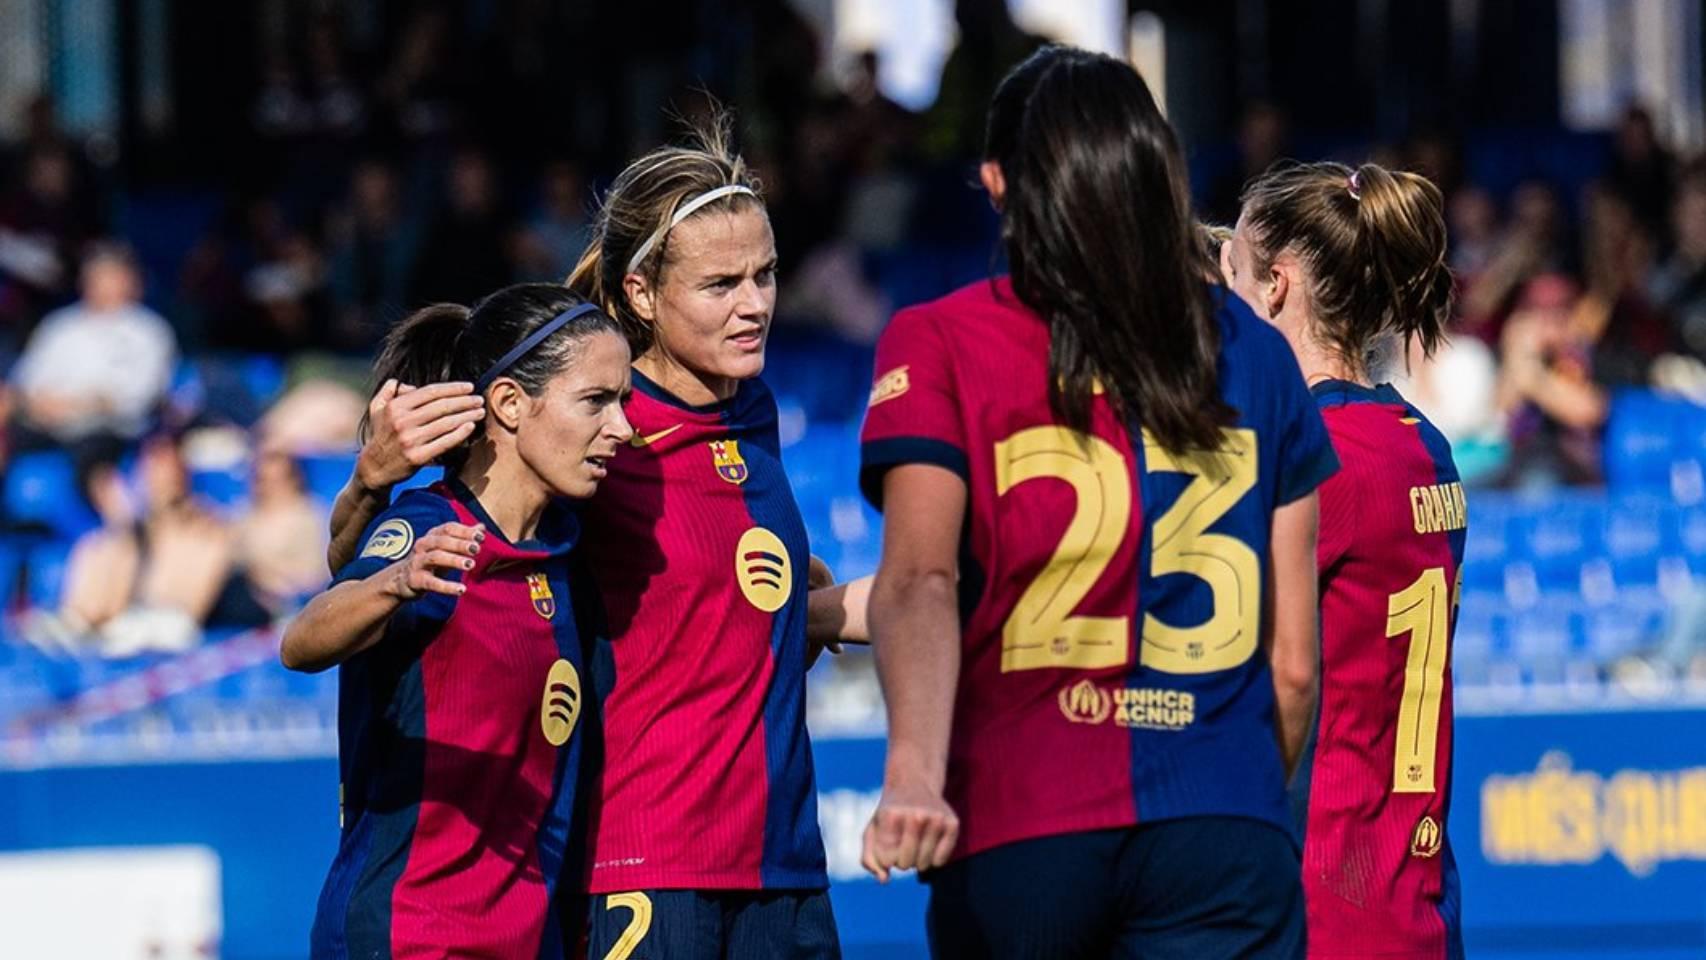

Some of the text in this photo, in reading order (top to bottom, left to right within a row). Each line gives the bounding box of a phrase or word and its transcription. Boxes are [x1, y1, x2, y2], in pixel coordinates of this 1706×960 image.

[994, 425, 1260, 674] 23
[1409, 482, 1467, 534] GRAHA
[1114, 689, 1194, 710] UNHCR
[1386, 564, 1463, 793] 1
